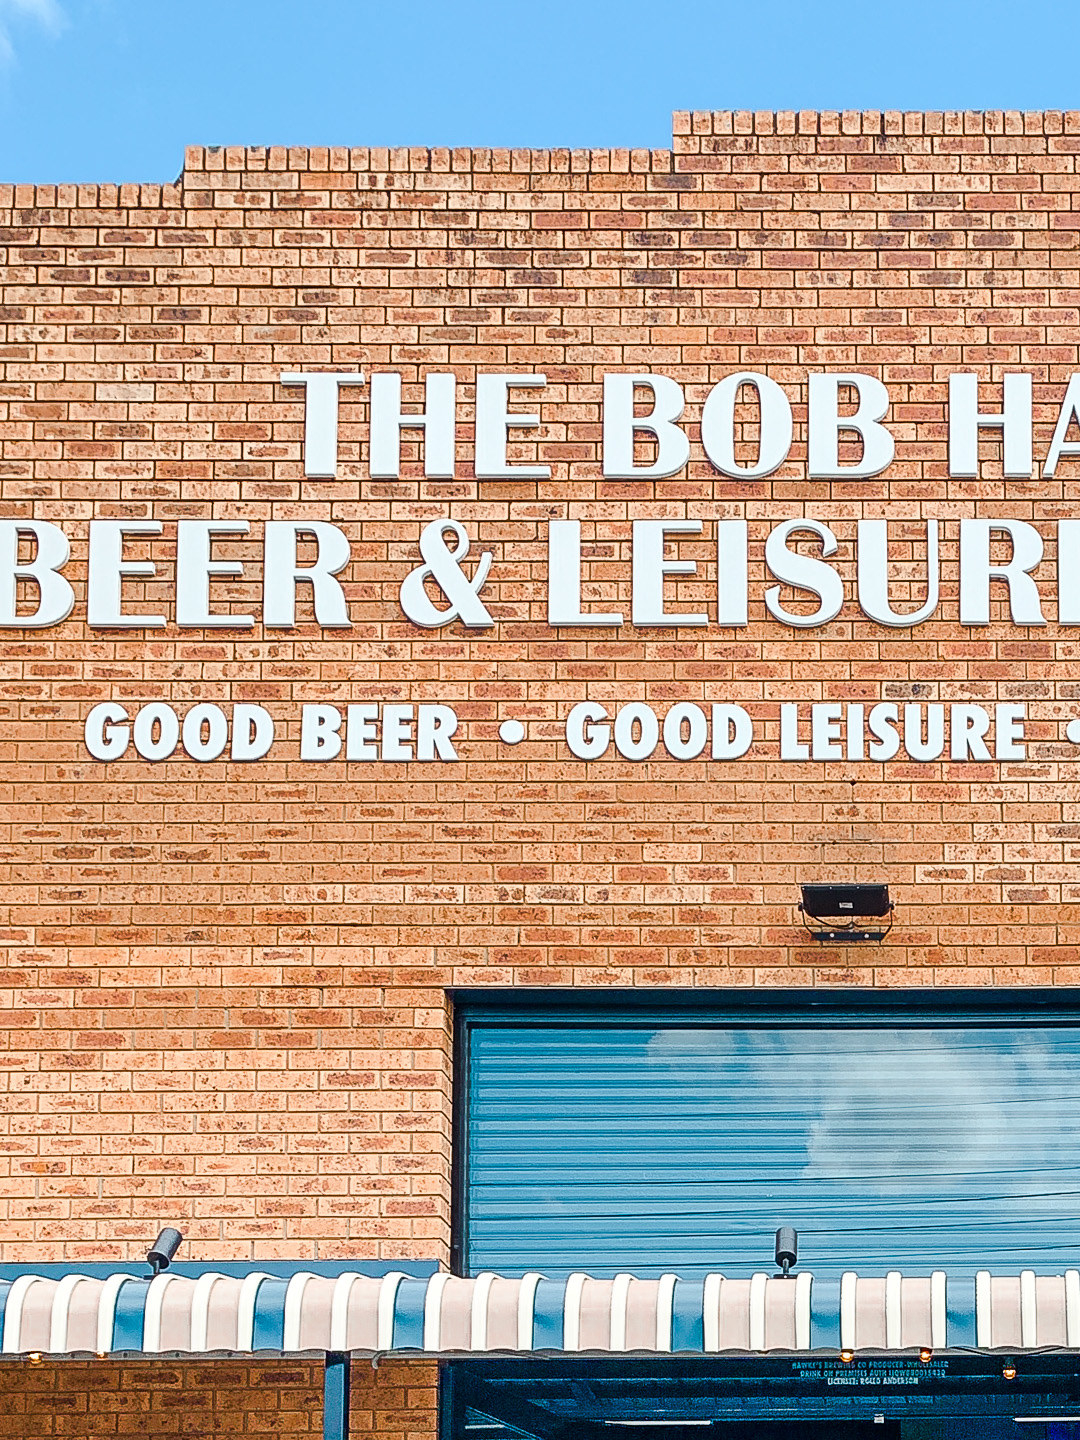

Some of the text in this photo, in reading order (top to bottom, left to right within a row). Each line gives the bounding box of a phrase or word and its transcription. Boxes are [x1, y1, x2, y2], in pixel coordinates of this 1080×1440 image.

[280, 371, 552, 478] THE
[603, 369, 895, 478] BOB
[0, 519, 353, 628] BEER
[400, 518, 495, 627] &
[84, 702, 275, 761] GOOD
[301, 703, 460, 761] BEER
[566, 701, 753, 761] GOOD
[780, 702, 1028, 761] LEISURE
